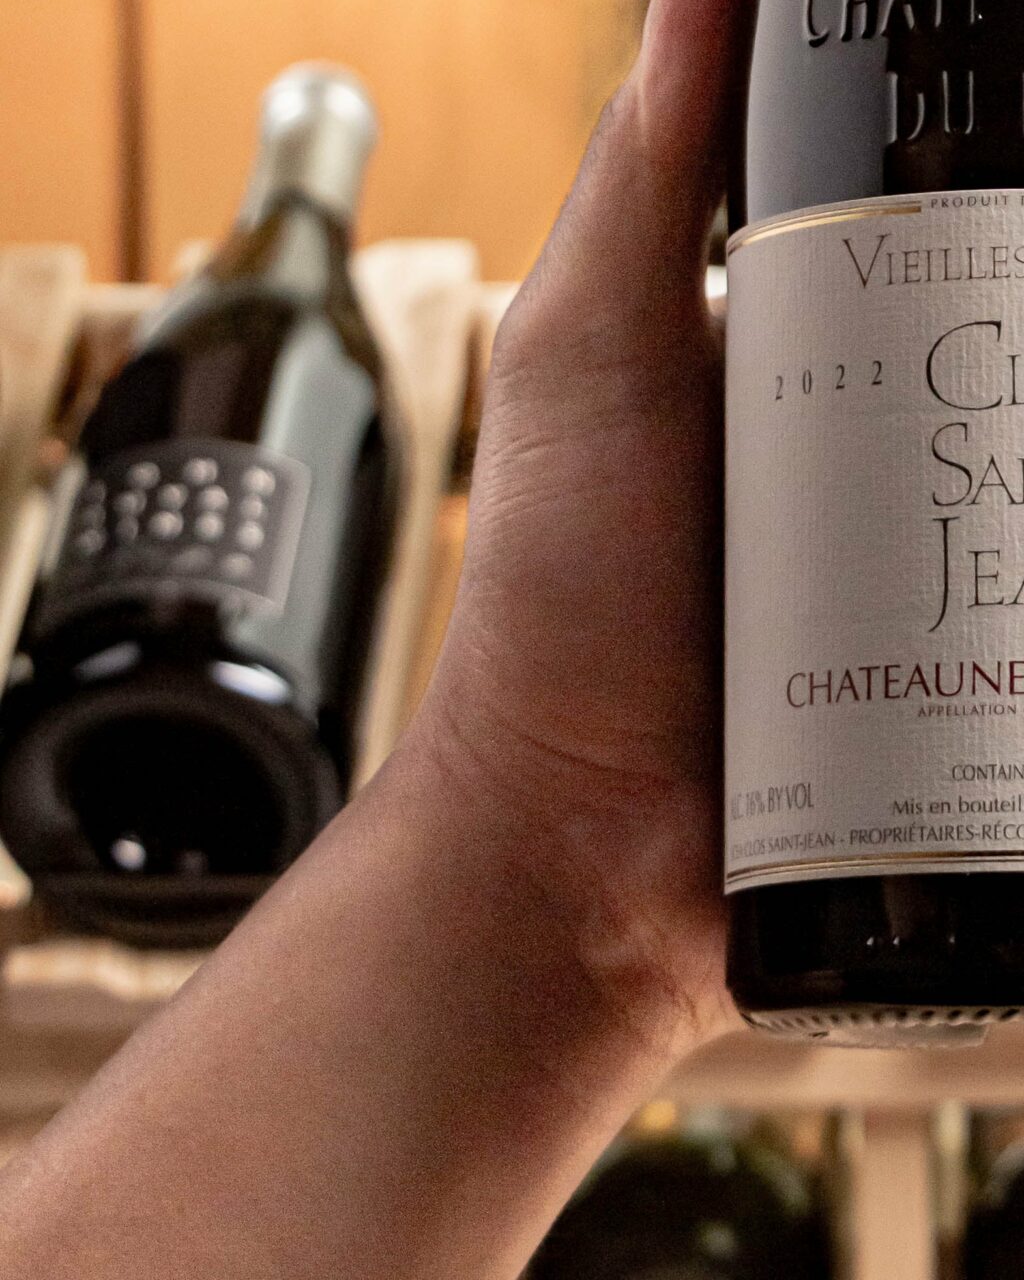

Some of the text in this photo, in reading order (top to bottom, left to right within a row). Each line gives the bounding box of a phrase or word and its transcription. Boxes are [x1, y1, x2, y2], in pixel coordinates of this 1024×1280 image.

[930, 195, 1009, 210] PRODUIT
[775, 360, 883, 401] 2022
[918, 703, 1017, 718] APPELLATION
[767, 786, 784, 814] BY
[786, 782, 814, 811] VOL
[892, 798, 923, 816] Mis
[929, 800, 951, 814] en
[768, 831, 836, 854] SAINT-JEAN
